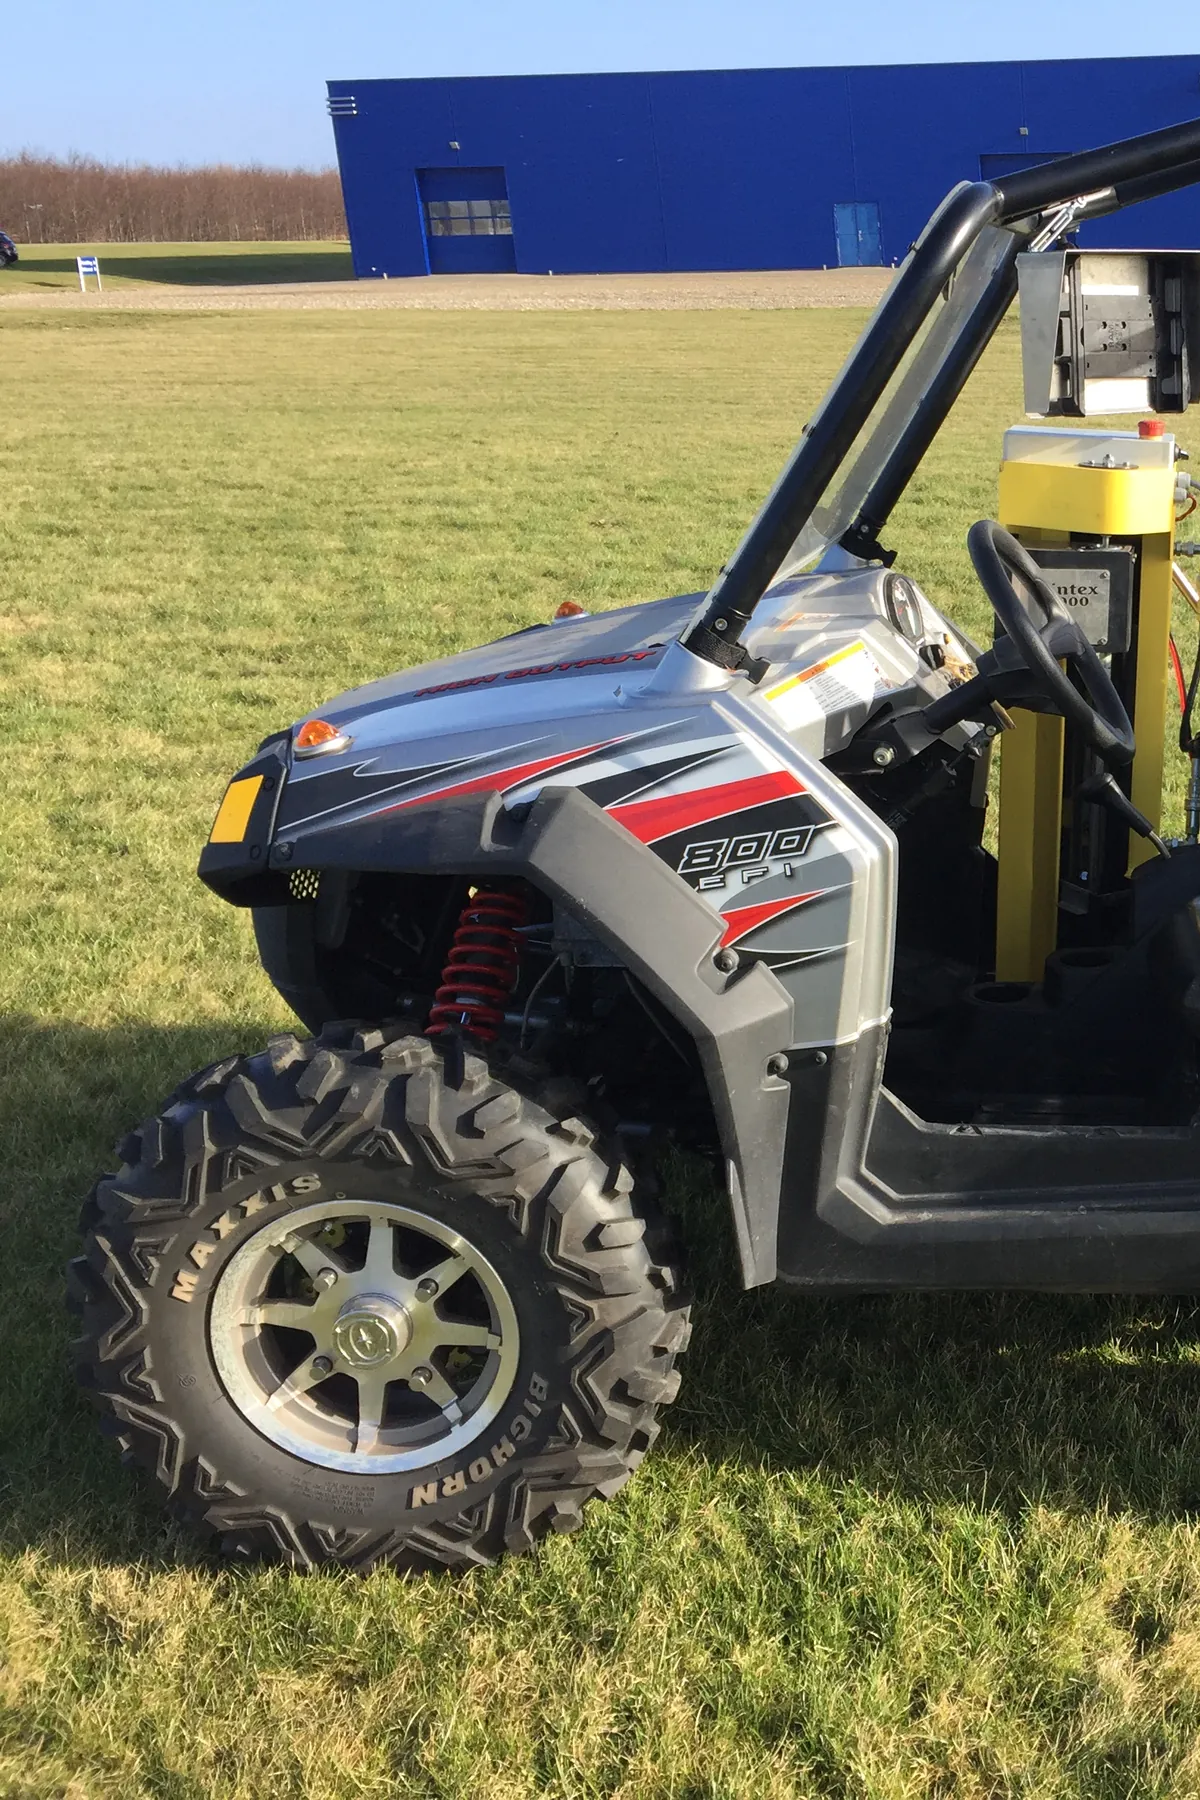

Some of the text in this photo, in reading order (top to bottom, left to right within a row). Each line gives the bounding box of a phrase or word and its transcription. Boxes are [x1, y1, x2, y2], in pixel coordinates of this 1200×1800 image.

[504, 651, 656, 679] OUTPUT
[677, 825, 815, 873] 800
[699, 863, 793, 890] EFI
[170, 1173, 322, 1303] MAXXIS
[411, 1371, 549, 1508] BIGHORN
